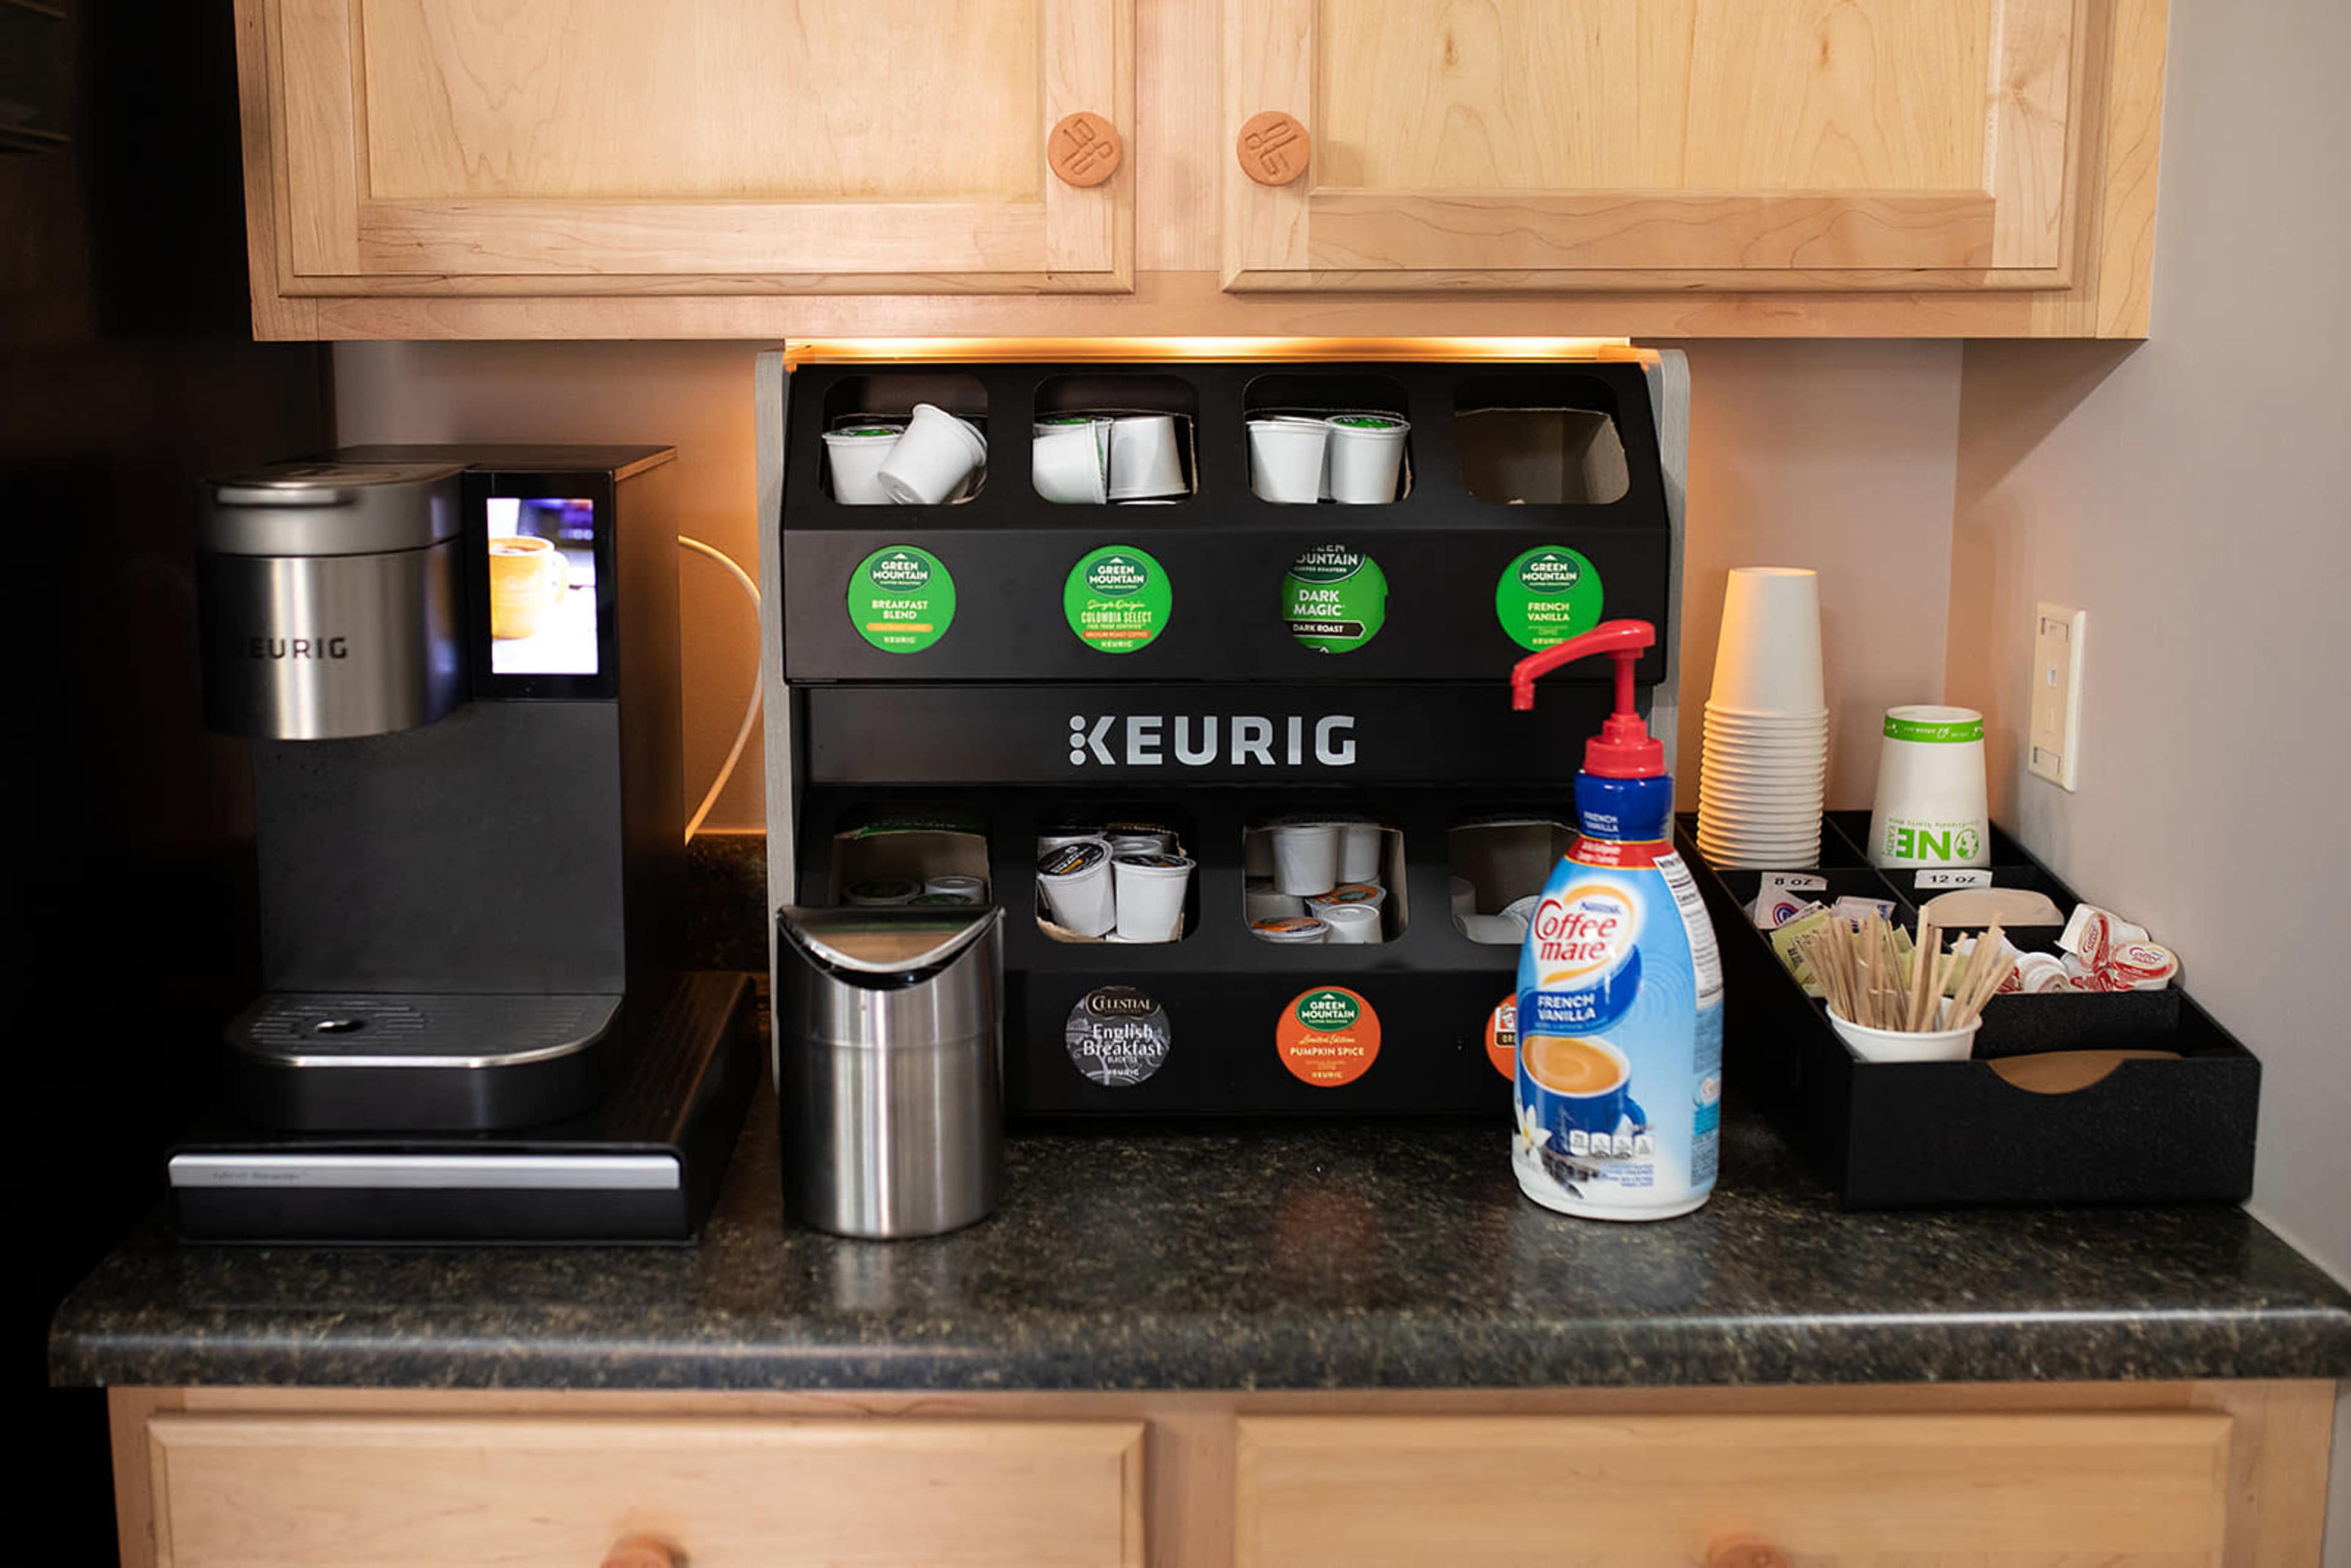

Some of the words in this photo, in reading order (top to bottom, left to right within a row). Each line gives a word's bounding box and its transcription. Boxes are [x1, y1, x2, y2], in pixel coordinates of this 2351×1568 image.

[882, 561, 918, 571] GREEN
[1097, 565, 1134, 575] GREEN
[1530, 563, 1568, 572] GREEN
[872, 571, 928, 580] MOUNTAIN
[1089, 575, 1145, 584] MOUNTAIN
[1522, 572, 1578, 581] MOUNTAIN
[1299, 590, 1340, 602] DARK
[872, 599, 929, 609] BREAKFAST
[1528, 602, 1570, 611] FRENCH
[883, 610, 917, 620] BLEND
[1293, 604, 1342, 616] MAGIC
[1123, 610, 1152, 623] SELECT
[1527, 612, 1570, 621] VANILLA
[1292, 624, 1316, 632] DARK
[1316, 625, 1344, 633] ROAST
[1069, 715, 1356, 766] KEURIG
[1775, 877, 1785, 886] 8
[1929, 874, 1949, 883] 12
[1534, 899, 1618, 941] Coffee
[1540, 941, 1606, 961] mate
[1092, 996, 1150, 1011] CELESTIAL
[1537, 992, 1596, 1008] FRENCH
[1310, 1001, 1346, 1010] GREEN
[1301, 1010, 1355, 1019] MOUNTAIN
[1537, 1006, 1597, 1022] VANILLA
[1093, 1023, 1153, 1043] English
[1083, 1040, 1162, 1056] Breakfast
[1290, 1047, 1336, 1056] PUMPKIN
[1337, 1047, 1365, 1056] SPICE
